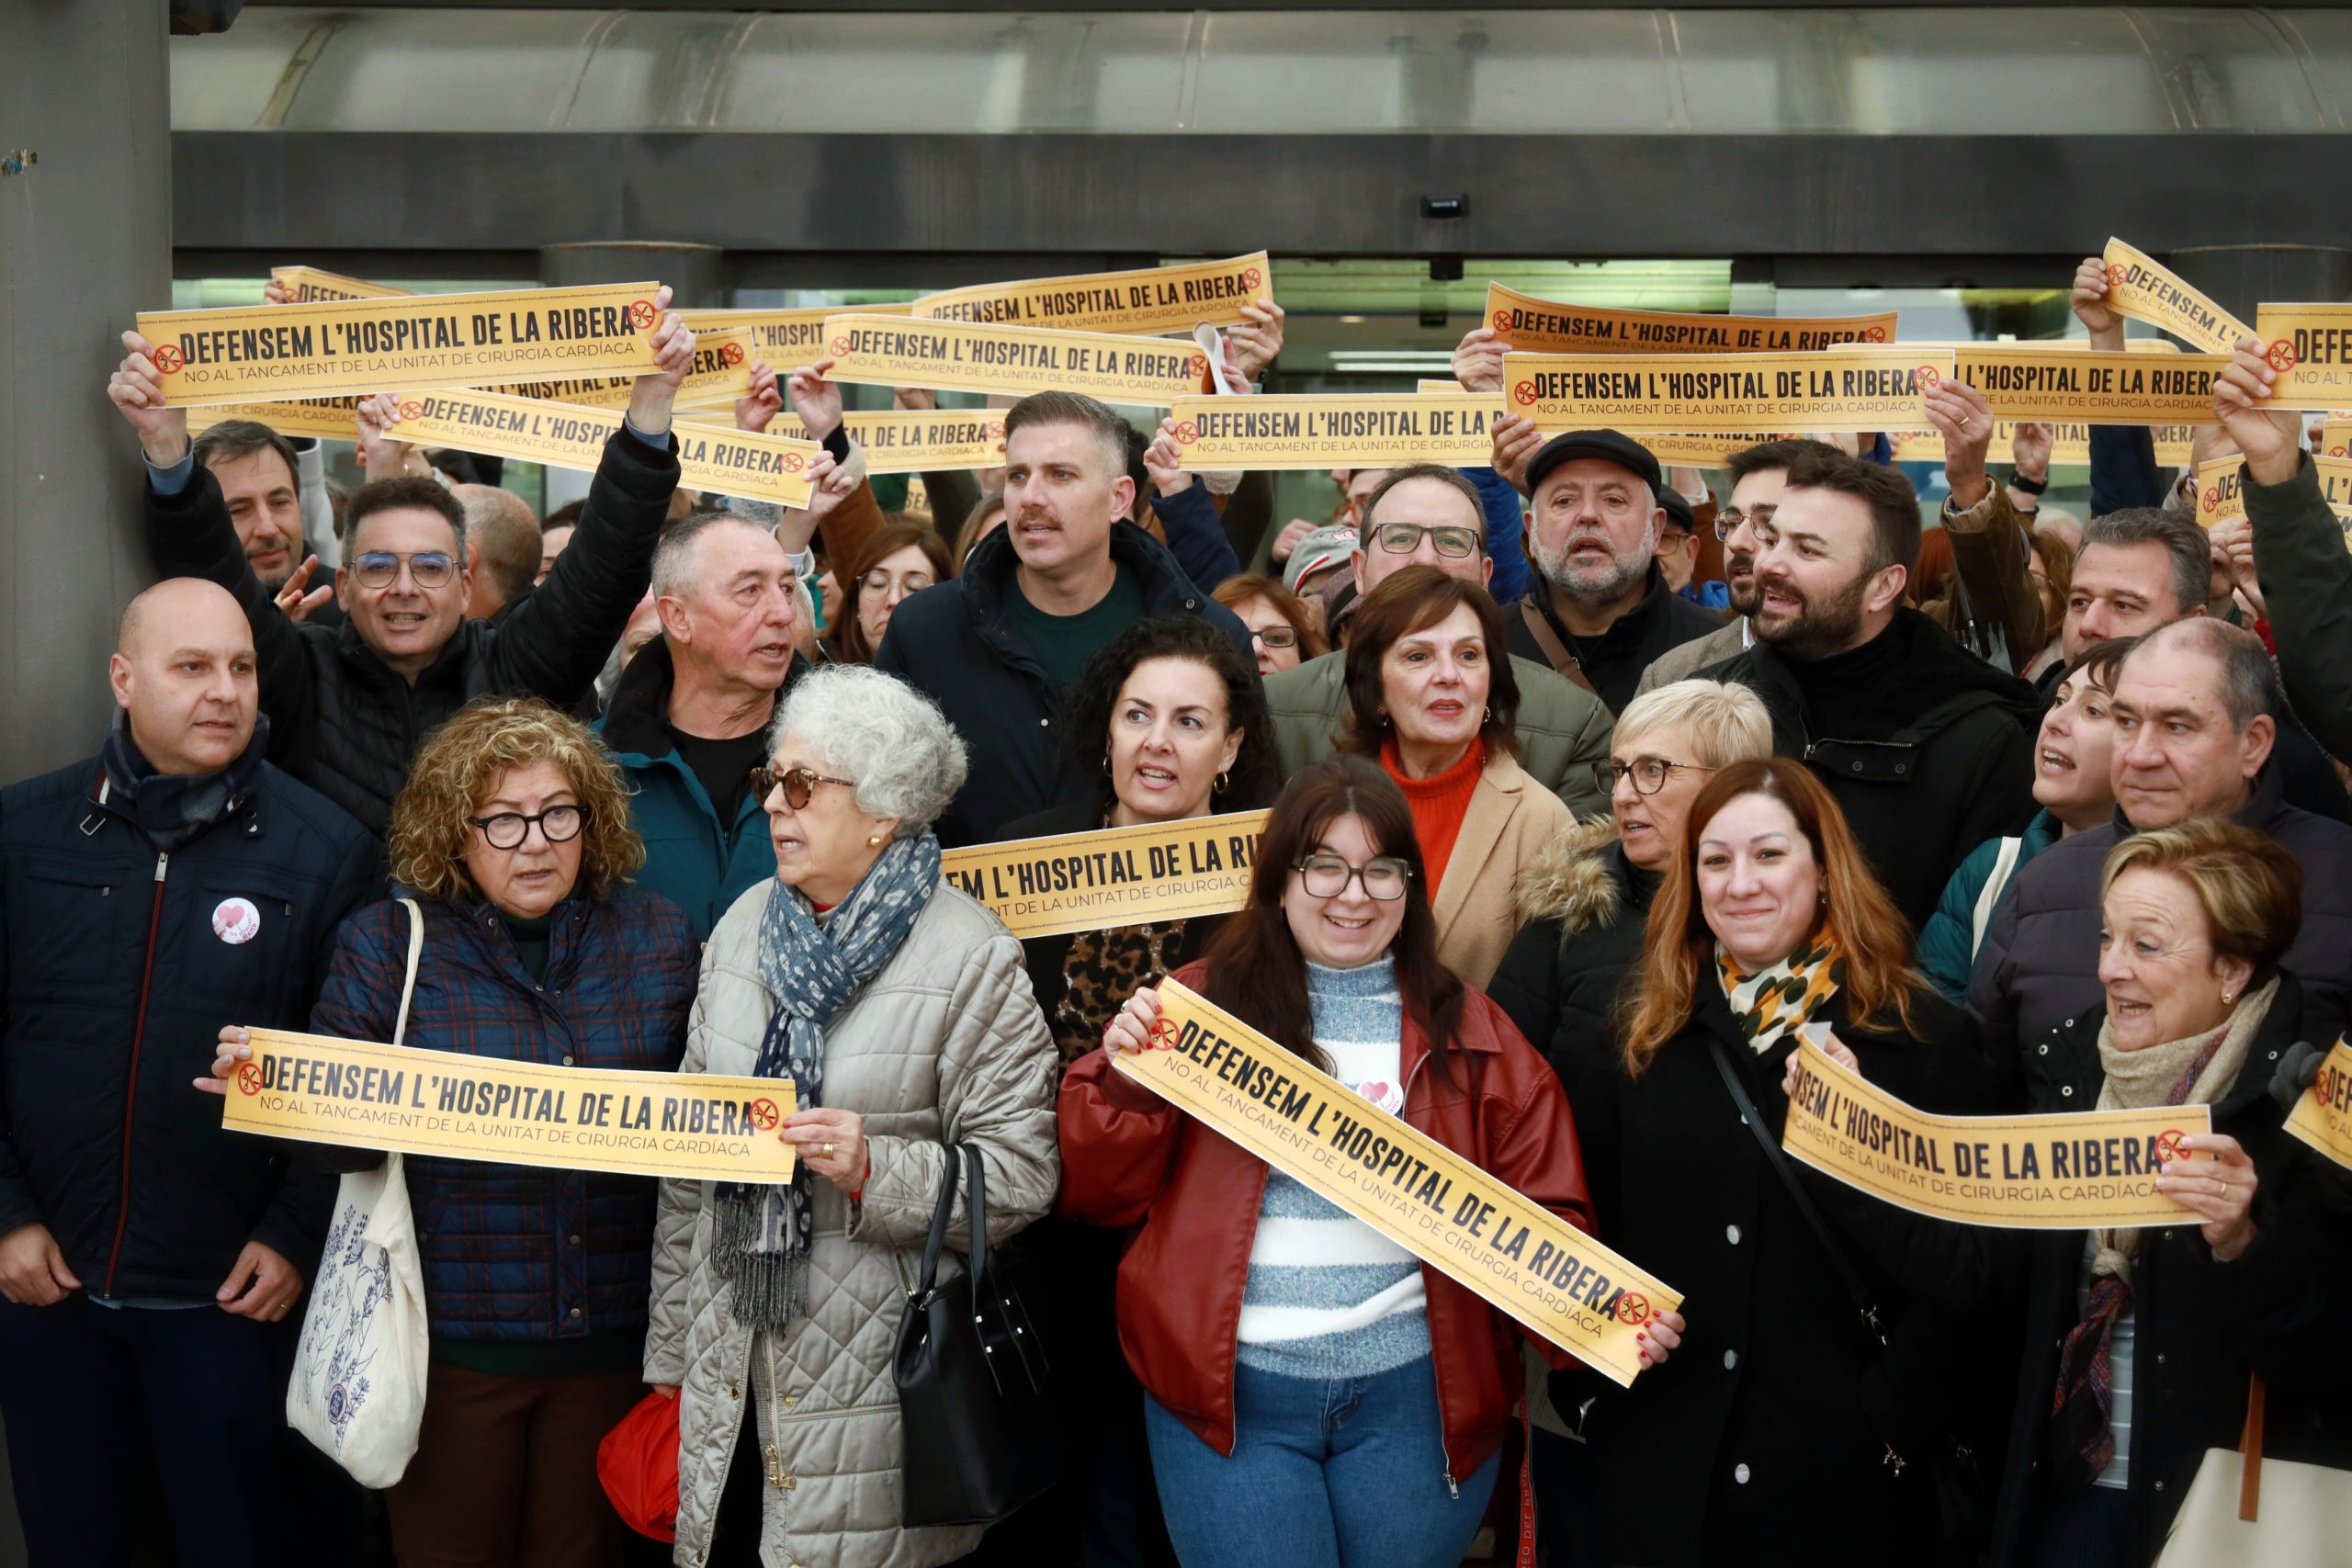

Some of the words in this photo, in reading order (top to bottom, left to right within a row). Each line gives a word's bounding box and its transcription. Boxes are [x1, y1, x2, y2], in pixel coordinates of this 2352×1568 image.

[1025, 288, 1125, 318] L'HOSPITAL
[1129, 285, 1152, 309] DE
[1157, 283, 1180, 306] LA
[1183, 274, 1249, 302] RIBERA
[2125, 263, 2217, 332] DEFENSEM
[180, 325, 312, 365] DEFENSEM
[322, 316, 465, 355] L'HOSPITAL
[472, 313, 503, 345] DE
[510, 311, 540, 344] LA
[548, 305, 635, 341] RIBERA
[1512, 308, 1613, 338] DEFENSEM
[1620, 321, 1730, 346] L'HOSPITAL
[1737, 329, 1762, 348] DE
[1768, 331, 1791, 349] LA
[2120, 287, 2137, 299] NO
[2139, 294, 2154, 309] AL
[2154, 303, 2222, 349] TANCAMENT
[185, 370, 209, 383] NO
[213, 368, 233, 381] AL
[237, 361, 336, 379] TANCAMENT
[342, 360, 363, 373] DE
[368, 358, 388, 371] LA
[391, 354, 447, 369] UNITAT
[452, 353, 472, 366] DE
[477, 347, 552, 364] CIRURGIA
[555, 341, 635, 358] CARDÍACA
[850, 330, 947, 359] DEFENSEM
[954, 338, 1059, 369] L'HOSPITAL
[1067, 347, 1090, 371] DE
[1096, 350, 1117, 374] LA
[1125, 353, 1191, 379] RIBERA
[848, 356, 867, 367] NO
[869, 358, 884, 368] AL
[888, 359, 962, 374] TANCAMENT
[965, 366, 980, 377] DE
[985, 367, 1000, 378] LA
[1002, 369, 1046, 381] UNITAT
[1047, 372, 1064, 383] DE
[1067, 374, 1125, 388] CIRURGIA
[1126, 379, 1189, 392] CARDÍACA
[1535, 373, 1641, 399] DEFENSEM
[1649, 372, 1769, 400] L'HOSPITAL
[1777, 371, 1802, 398] DE
[1810, 370, 1835, 398] LA
[1843, 369, 1918, 397] RIBERA
[1966, 365, 2081, 392] L'HOSPITAL
[2088, 368, 2113, 393] DE
[2120, 369, 2143, 394] LA
[2295, 371, 2318, 384] NO
[2323, 371, 2342, 385] AL
[242, 404, 300, 420] CIRURGIA
[423, 398, 527, 433] DEFENSEM
[1537, 403, 1556, 414] NO
[1560, 404, 1577, 414] AL
[1579, 403, 1660, 414] TANCAMENT
[1664, 404, 1681, 414] DE
[1686, 404, 1702, 415] LA
[1705, 403, 1753, 414] UNITAT
[1757, 403, 1775, 414] DE
[1779, 402, 1843, 413] CIRURGIA
[1847, 401, 1917, 412] CARDÍACA
[2000, 395, 2016, 404] LA
[2019, 395, 2064, 406] UNITAT
[2068, 396, 2086, 407] DE
[2088, 397, 2151, 408] CIRURGIA
[2154, 397, 2212, 410] CARDÍAC
[418, 420, 439, 431] NO
[440, 424, 457, 434] AL
[461, 426, 539, 446] TANCAMENT
[541, 440, 560, 451] DE
[562, 445, 578, 454] LA
[876, 426, 896, 447] DE
[902, 425, 922, 446] LA
[928, 423, 987, 445] RIBERA
[1197, 412, 1300, 438] DEFENSEM
[1308, 412, 1422, 436] L'HOSPITAL
[1430, 411, 1453, 435] DE
[1461, 411, 1485, 435] LA
[683, 439, 706, 462] LA
[713, 444, 783, 475] RIBERA
[1197, 442, 1216, 453] NO
[1219, 442, 1235, 452] AL
[1238, 441, 1317, 452] TANCAMENT
[1321, 441, 1338, 451] DE
[1342, 441, 1358, 451] LA
[1361, 440, 1407, 451] UNITAT
[1410, 440, 1427, 450] DE
[1430, 436, 1494, 450] CIRURGIA
[713, 468, 779, 487] CARDÍACA
[2216, 508, 2228, 519] NO
[2229, 503, 2242, 516] AL
[992, 850, 1143, 898] L'HOSPITAL
[1148, 843, 1182, 879] DE
[1189, 840, 1223, 874] LA
[1014, 900, 1038, 916] DE
[1042, 897, 1062, 912] LA
[1066, 889, 1124, 908] UNITAT
[1129, 886, 1151, 901] DE
[1156, 876, 1235, 897] CIRURGIA
[261, 1055, 403, 1105] DEFENSEM
[412, 1074, 567, 1123] L'HOSPITAL
[578, 1092, 613, 1127] DE
[619, 1095, 650, 1130] LA
[662, 1098, 754, 1136] RIBERA
[260, 1095, 284, 1111] NO
[287, 1100, 308, 1114] AL
[313, 1102, 423, 1128] TANCAMENT
[426, 1117, 450, 1132] DE
[456, 1120, 476, 1134] LA
[481, 1123, 544, 1140] UNITAT
[548, 1129, 571, 1144] DE
[576, 1132, 658, 1150] CIRURGIA
[663, 1139, 750, 1156] CARDÍACA
[1830, 1092, 1945, 1174] L'HOSPITAL
[1954, 1142, 1991, 1179] DE
[2002, 1143, 2040, 1179] LA
[2051, 1135, 2162, 1179] RIBERA
[1174, 1020, 1312, 1122] DEFENSEM
[1306, 1101, 1453, 1214] L'HOSPITAL
[1453, 1192, 1497, 1237] DE
[1490, 1216, 1530, 1261] LA
[1528, 1240, 1625, 1322] RIBERA
[1839, 1139, 1856, 1160] DE
[1858, 1151, 1873, 1169] LA
[1877, 1159, 1927, 1189] UNITAT
[1932, 1179, 1955, 1195] DE
[1961, 1185, 2054, 1201] CIRURGIA
[2059, 1181, 2164, 1201] CARDÍACA
[1164, 1055, 1190, 1077] NO
[1190, 1074, 1209, 1093] AL
[1216, 1086, 1313, 1152] TANCAMENT
[1312, 1147, 1338, 1169] DE
[1338, 1163, 1357, 1184] LA
[1362, 1178, 1419, 1219] UNITAT
[1419, 1213, 1443, 1236] DE
[1444, 1231, 1518, 1285] CIRURGIA
[1521, 1280, 1602, 1338] CARDÍACA
